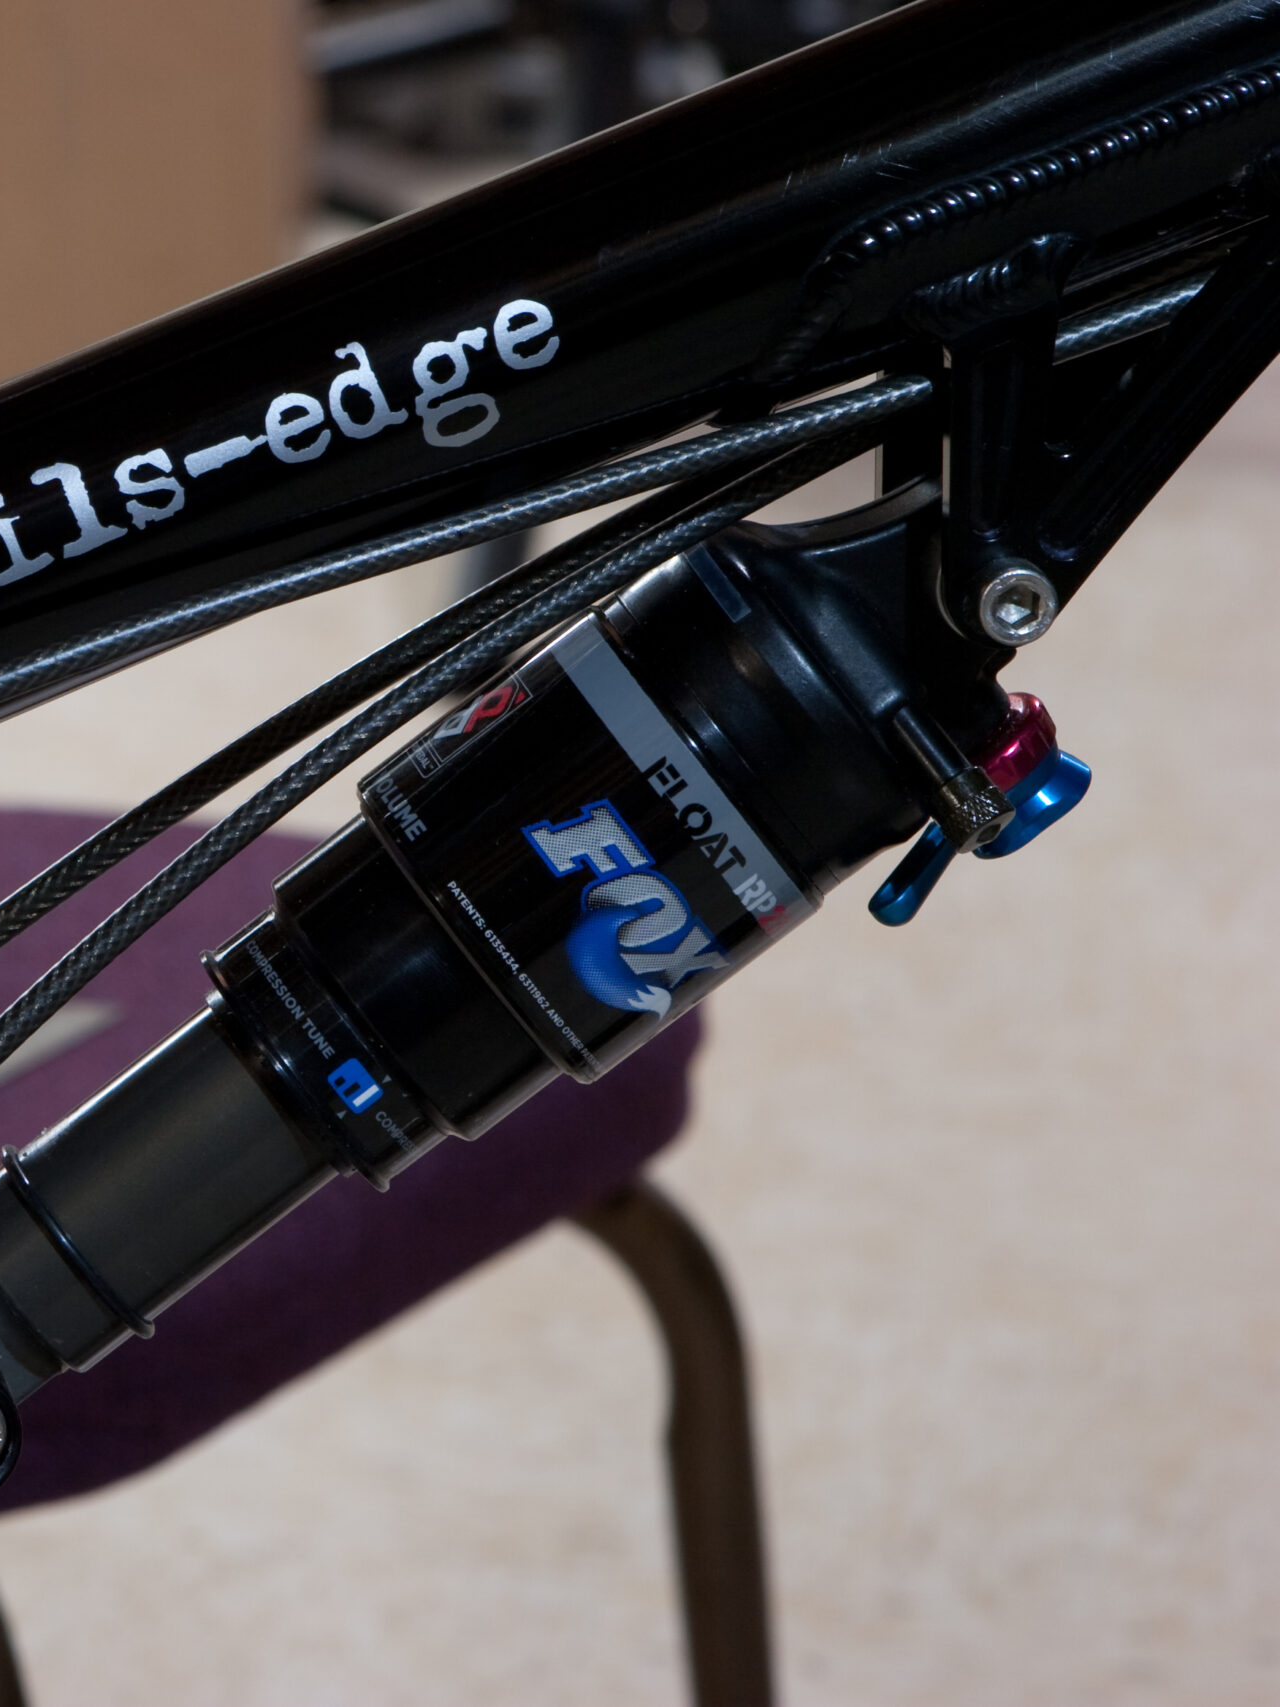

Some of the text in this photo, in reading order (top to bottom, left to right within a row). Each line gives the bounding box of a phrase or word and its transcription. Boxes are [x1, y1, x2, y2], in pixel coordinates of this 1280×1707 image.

[642, 756, 747, 872] FLOAT
[448, 880, 486, 930] PATENTS:
[484, 929, 520, 975] 6135434,
[518, 973, 551, 1010] 6311962
[546, 1008, 565, 1029] AND
[562, 1026, 585, 1051] OTHER
[521, 798, 730, 992] FOX
[246, 940, 336, 1060] COMPRESSION TUNE
